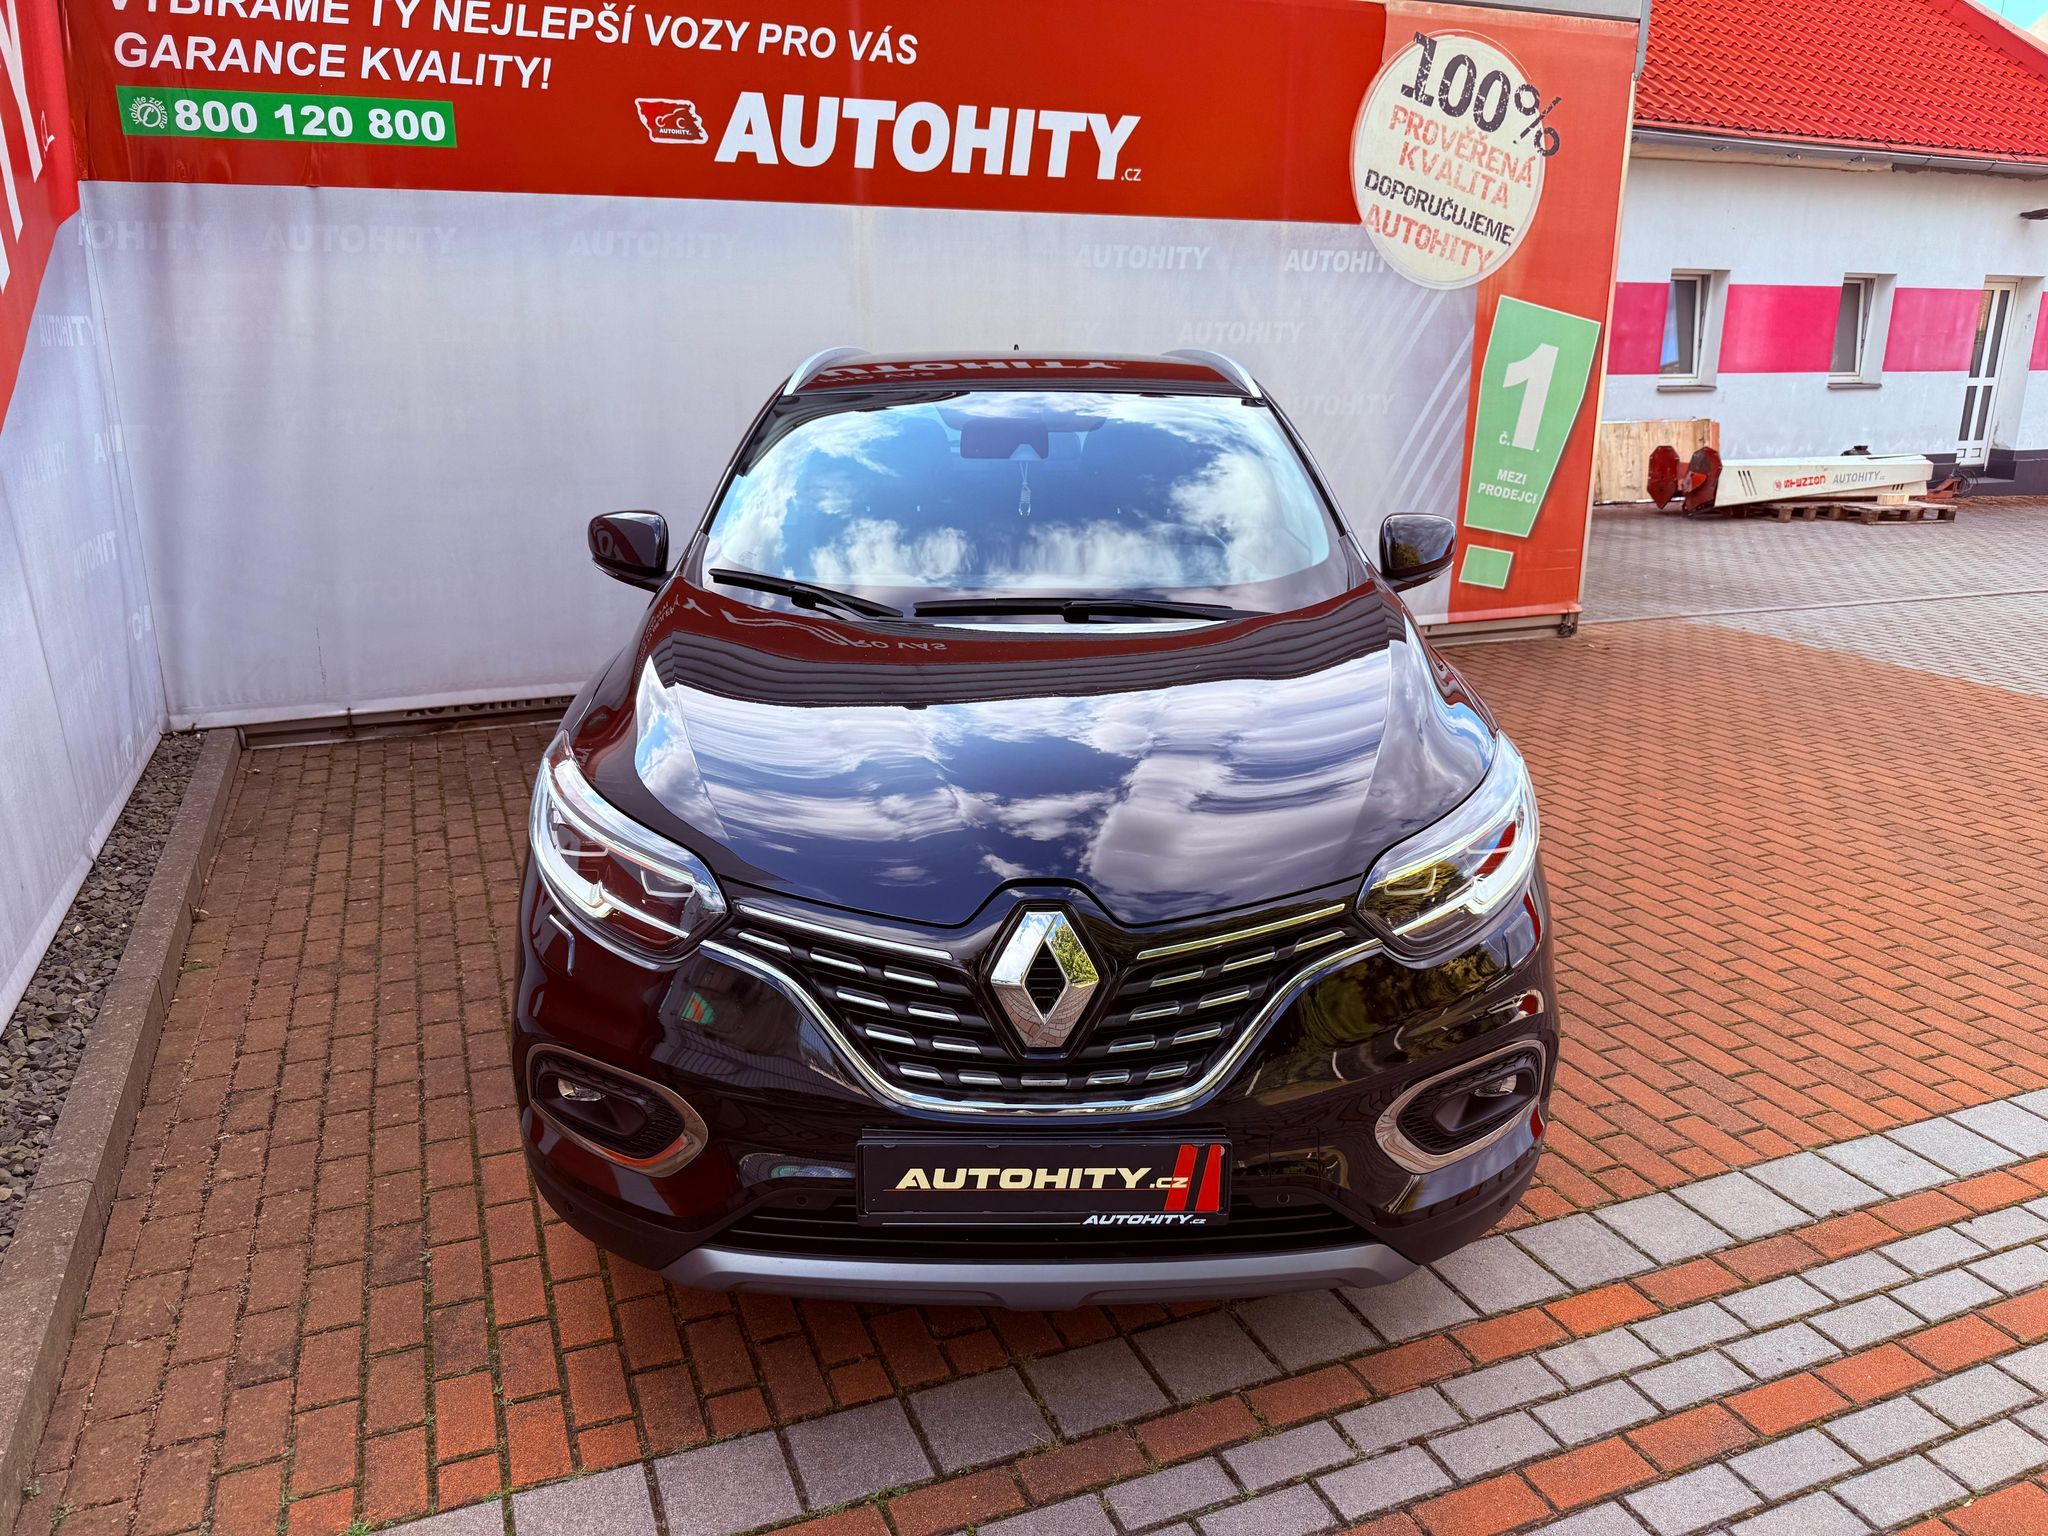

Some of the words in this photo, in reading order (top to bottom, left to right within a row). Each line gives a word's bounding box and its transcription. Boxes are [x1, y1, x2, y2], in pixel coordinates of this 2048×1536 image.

[114, 32, 347, 79] GARANCE
[360, 46, 552, 90] KVALITY!
[644, 15, 750, 52] VOZY
[756, 24, 836, 59] PRO
[848, 26, 918, 66] VÁS
[174, 99, 258, 133] 800
[274, 105, 354, 137] 120
[368, 109, 446, 141] 800
[1400, 31, 1563, 158] 100%
[1388, 104, 1537, 189] PROVĚŘENÁ
[1398, 140, 1509, 210] KVALITA
[1364, 168, 1516, 247] DOPORUČUJEME
[1364, 203, 1494, 274] AUTOHITY
[1478, 482, 1538, 504] PRODEJCI
[1497, 468, 1527, 486] MEZI
[895, 1168, 1189, 1190] AUTOHITY.cz
